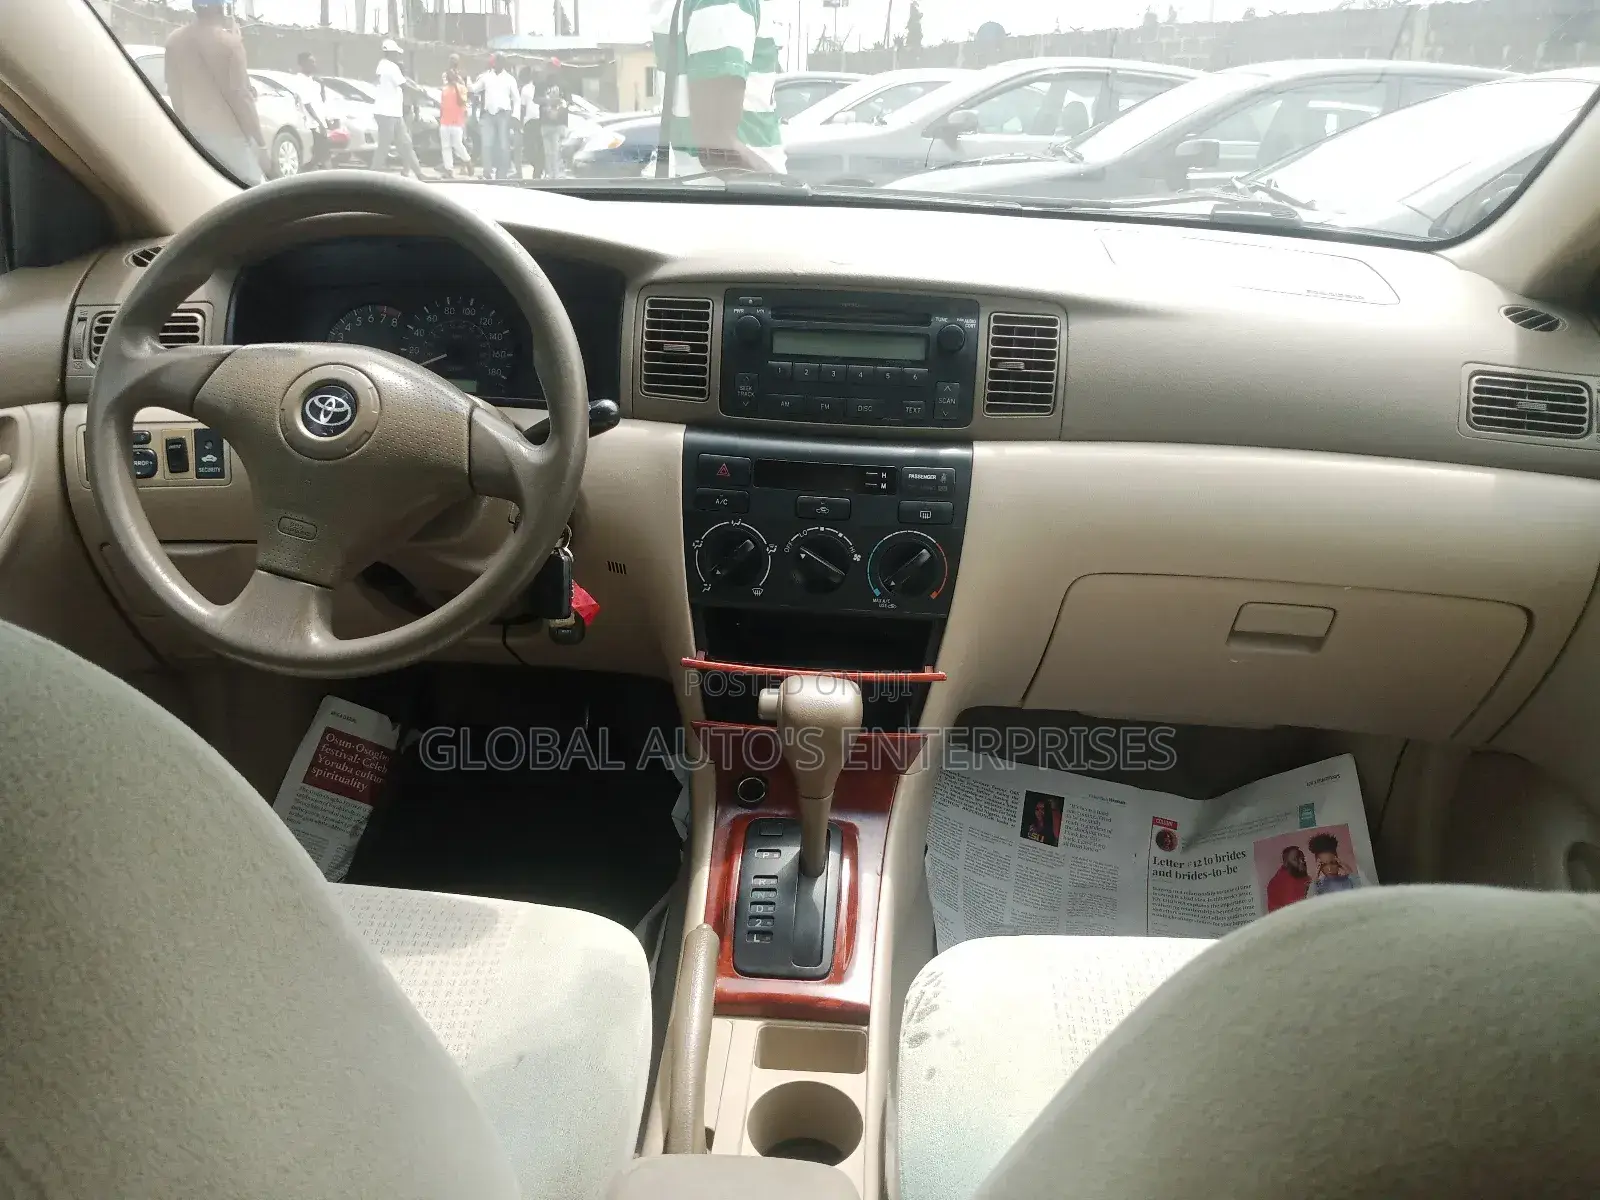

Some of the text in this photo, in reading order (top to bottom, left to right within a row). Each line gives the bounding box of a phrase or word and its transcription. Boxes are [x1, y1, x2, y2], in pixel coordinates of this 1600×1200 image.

[444, 307, 455, 315] 80
[462, 307, 476, 316] 100
[355, 316, 362, 326] 5
[367, 314, 374, 323] 6
[380, 313, 387, 323] 7
[391, 317, 398, 327] 8
[426, 314, 438, 322] 60
[480, 317, 493, 326] 120
[344, 322, 351, 331] 4
[413, 328, 425, 337] 40
[489, 332, 503, 341] 140
[488, 368, 502, 376] 180
[777, 367, 782, 375] 1
[858, 371, 863, 379] 4
[905, 407, 922, 415] TEXT
[715, 498, 728, 506] A/C
[799, 530, 808, 538] LO
[783, 541, 794, 553] OFF
[320, 743, 361, 764] festival:
[318, 753, 353, 774] Yoruba
[311, 766, 368, 793] spirituality
[1153, 856, 1185, 868] Letter
[1203, 856, 1213, 866] to
[1215, 850, 1246, 864] brides
[1152, 864, 1238, 880] and brides-to-be
[756, 905, 764, 913] D
[753, 934, 760, 942] L
